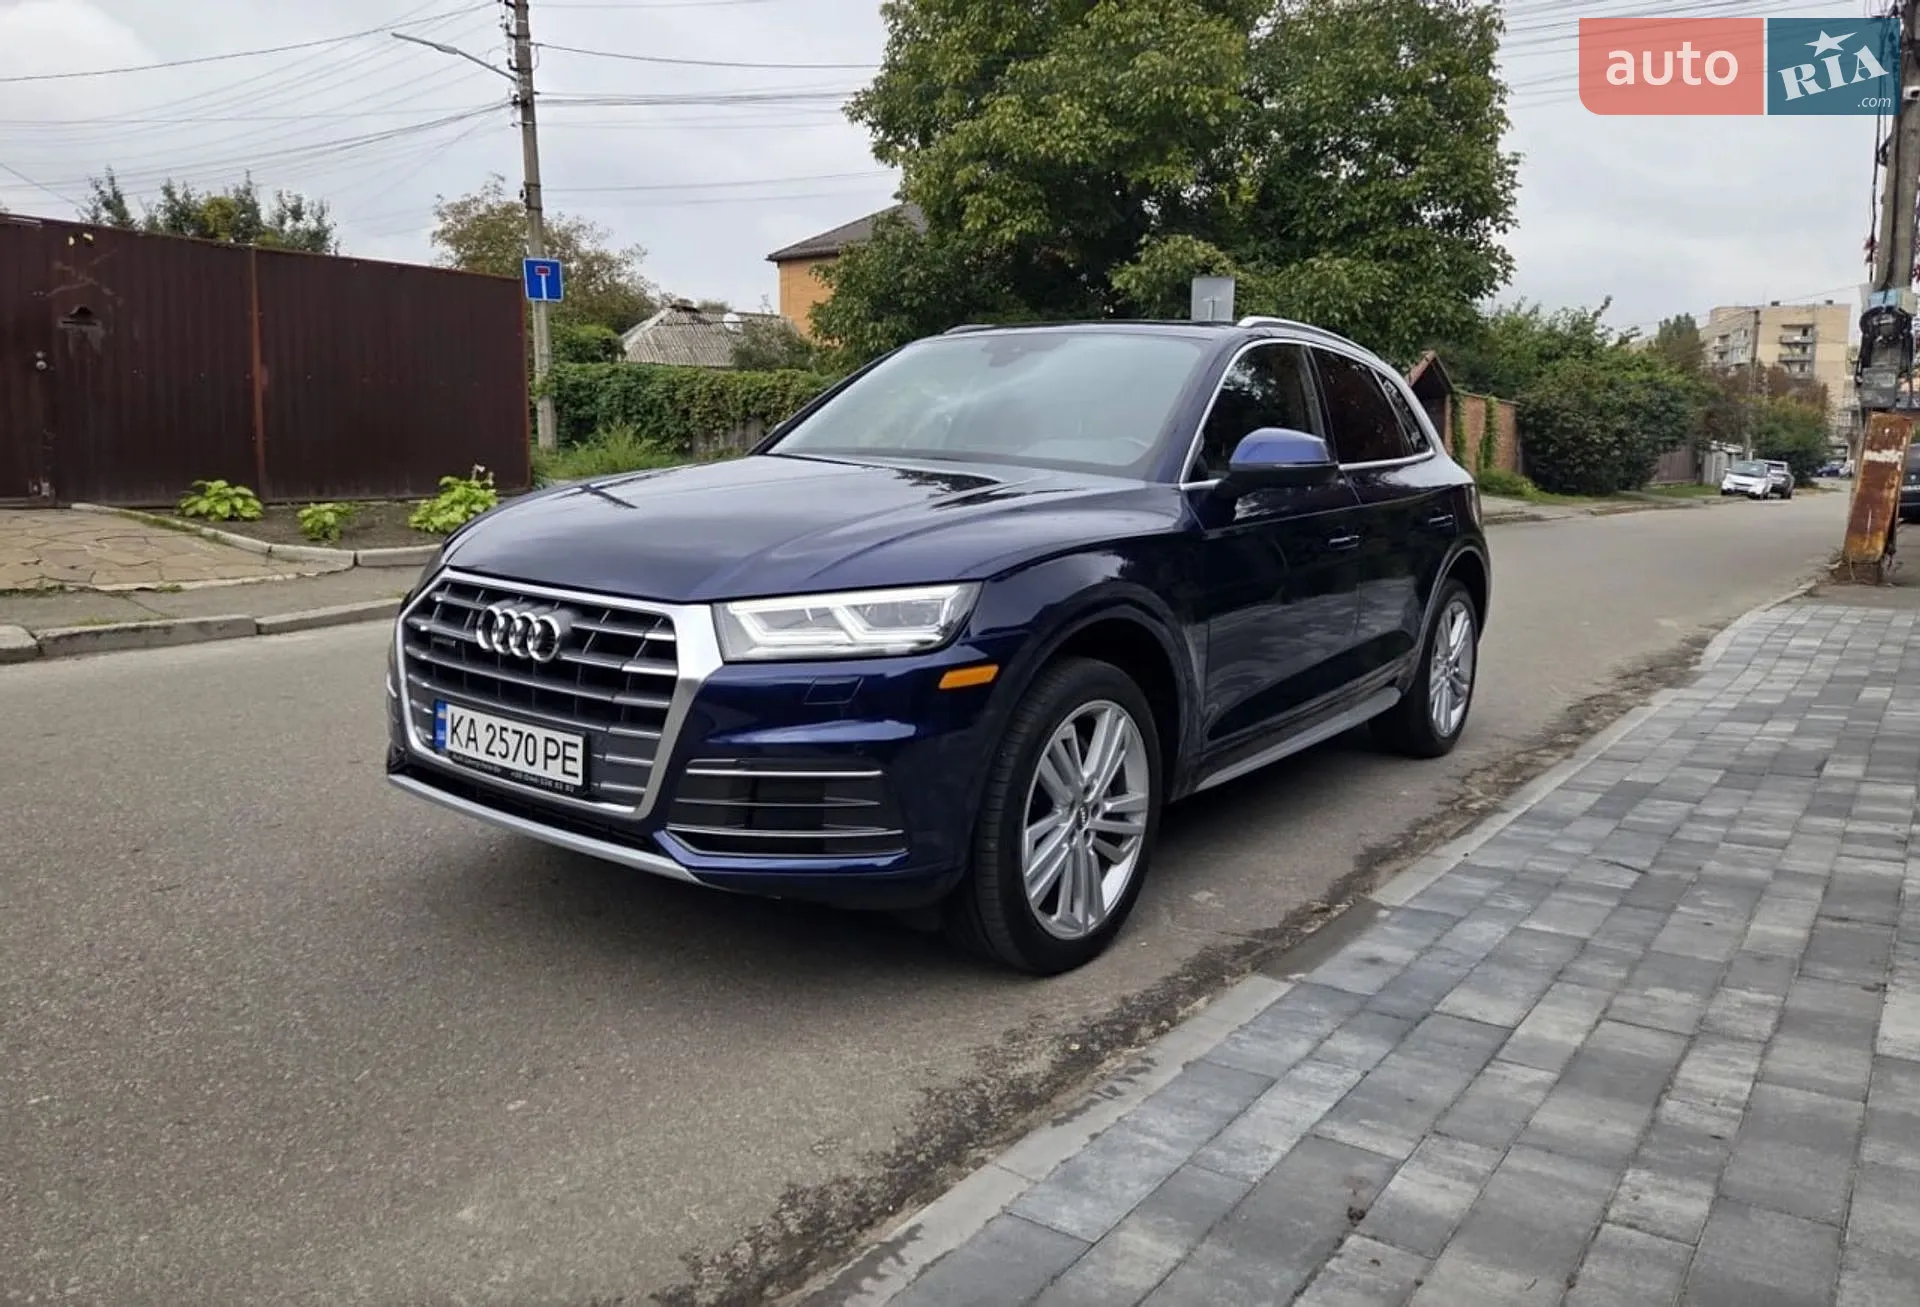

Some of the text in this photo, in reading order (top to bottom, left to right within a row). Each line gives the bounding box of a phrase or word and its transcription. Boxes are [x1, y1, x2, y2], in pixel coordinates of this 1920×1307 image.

[450, 712, 479, 752] KA
[485, 723, 538, 767] 2570
[543, 737, 580, 778] PE
